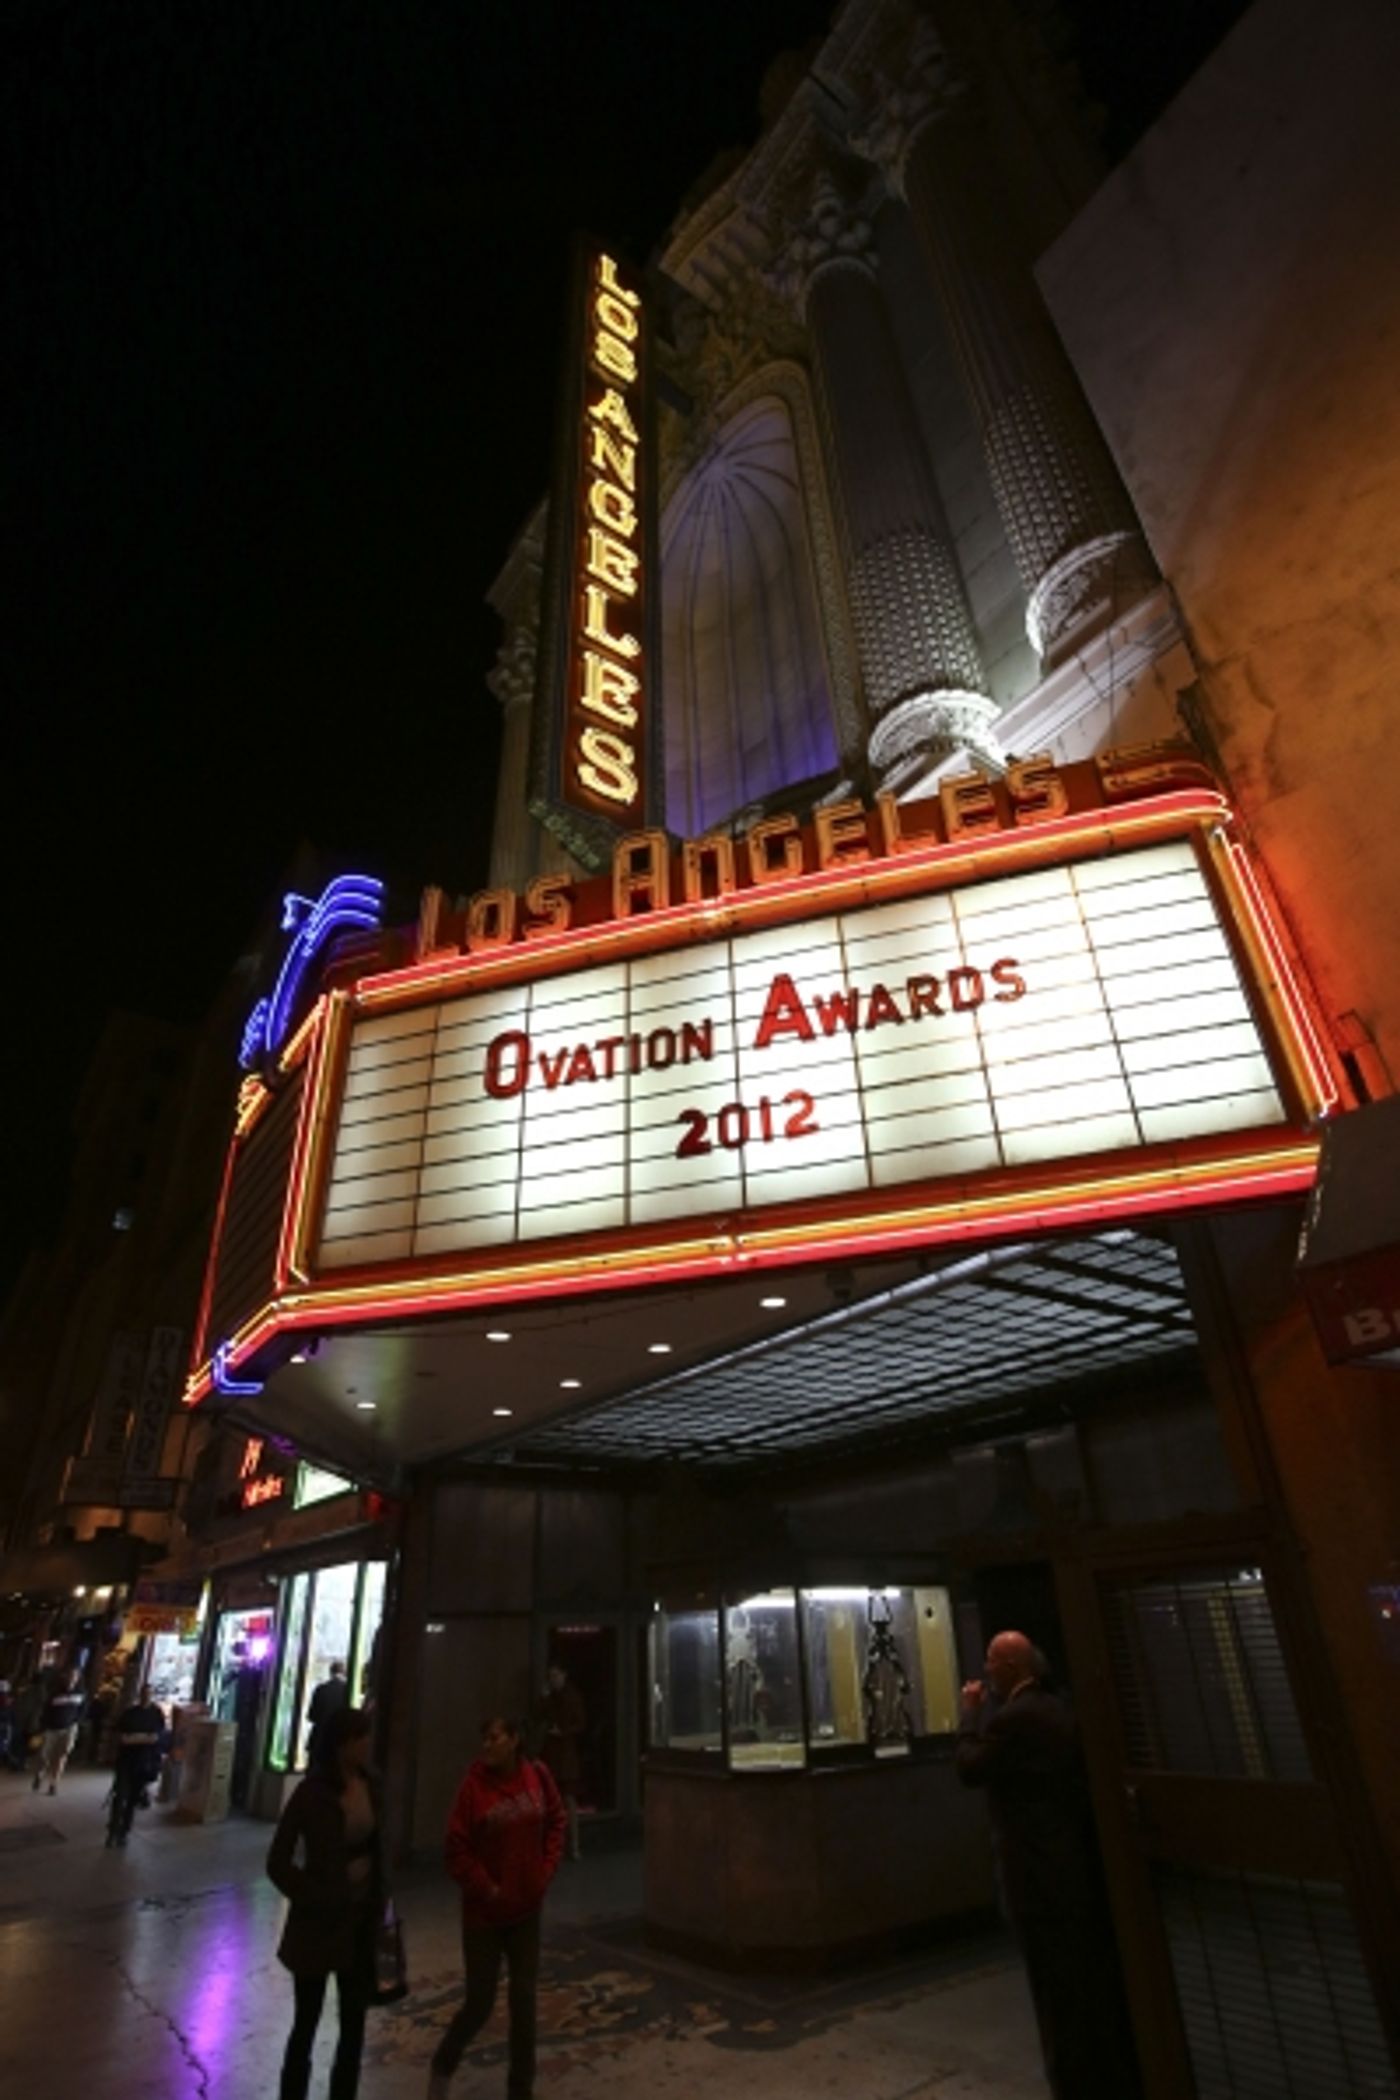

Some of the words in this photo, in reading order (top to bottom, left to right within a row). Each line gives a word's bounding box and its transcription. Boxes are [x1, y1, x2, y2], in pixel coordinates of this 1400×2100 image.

[595, 254, 641, 382] LOS
[578, 388, 641, 805] ANGELES
[418, 872, 573, 965] LOS
[613, 750, 1068, 919] ANGELES
[483, 1017, 713, 1100] OVATION
[754, 957, 1027, 1048] AWARDS
[675, 1089, 820, 1159] 2012
